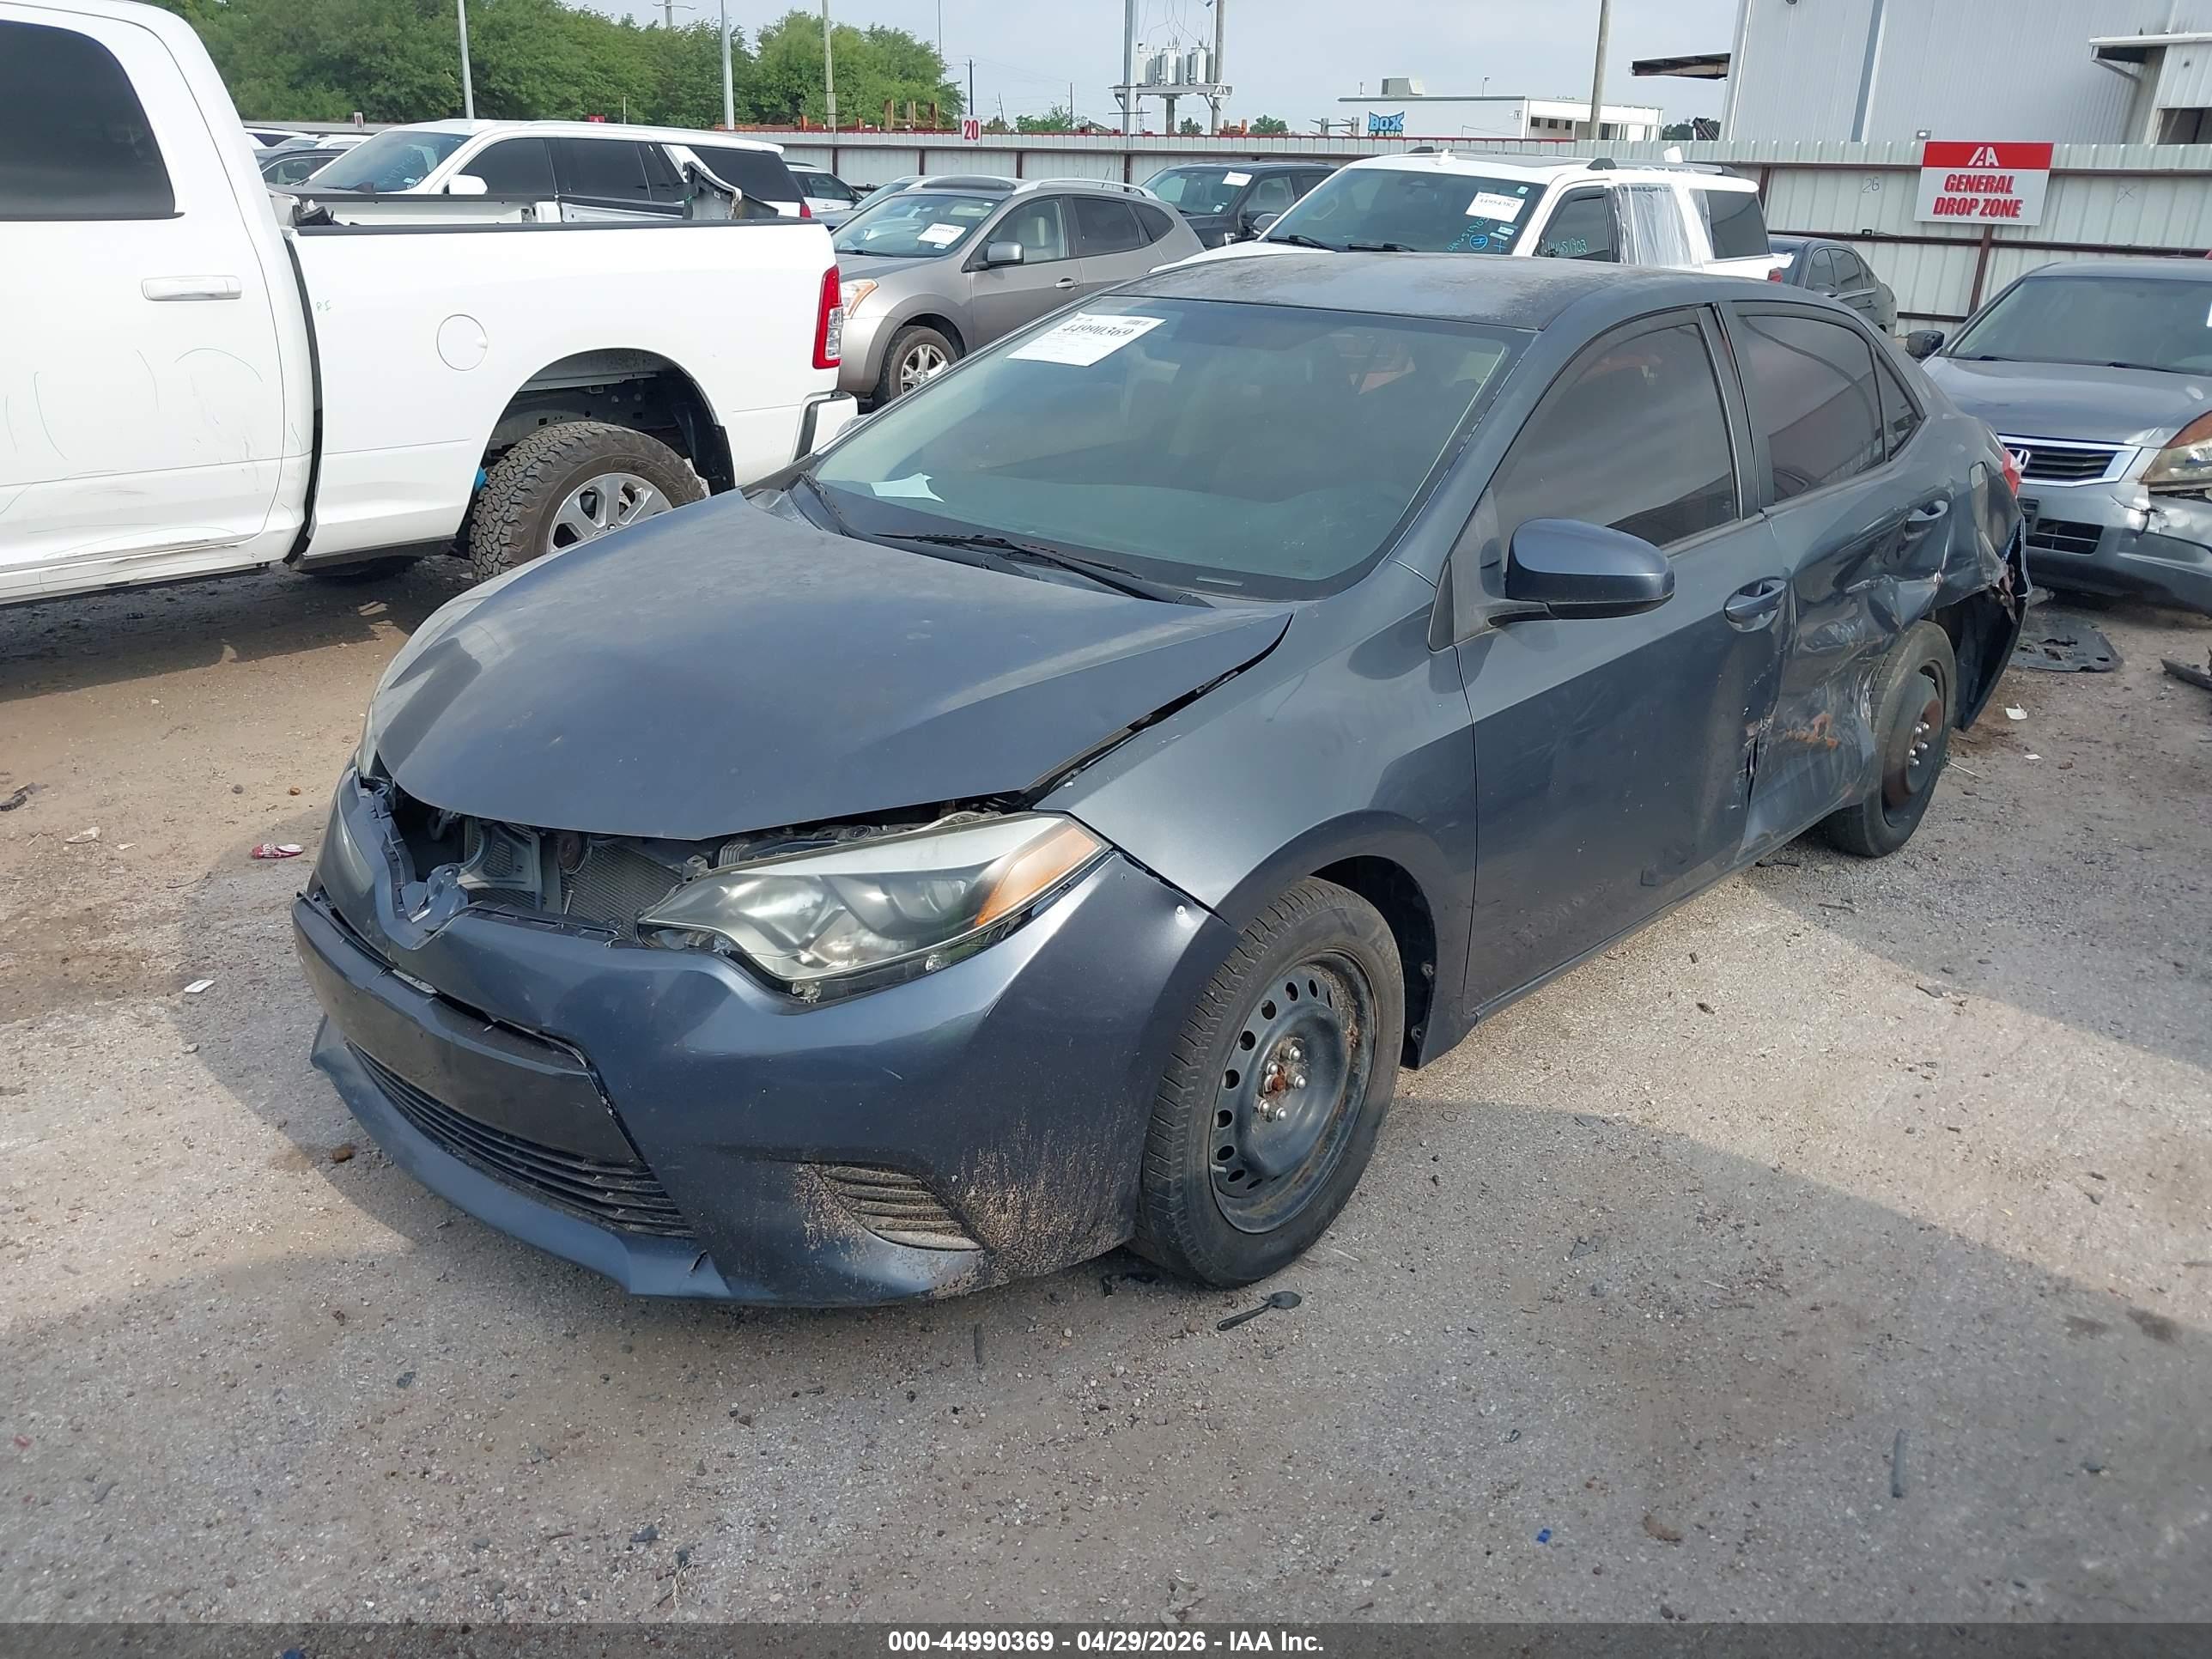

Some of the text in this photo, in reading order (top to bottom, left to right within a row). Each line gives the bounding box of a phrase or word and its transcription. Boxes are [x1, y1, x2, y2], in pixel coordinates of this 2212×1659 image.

[964, 119, 979, 140] 20
[1368, 111, 1405, 131] BOX
[1862, 177, 1881, 193] 26
[1944, 173, 2014, 194] GENERAL
[1933, 197, 2024, 218] DROP ZONE
